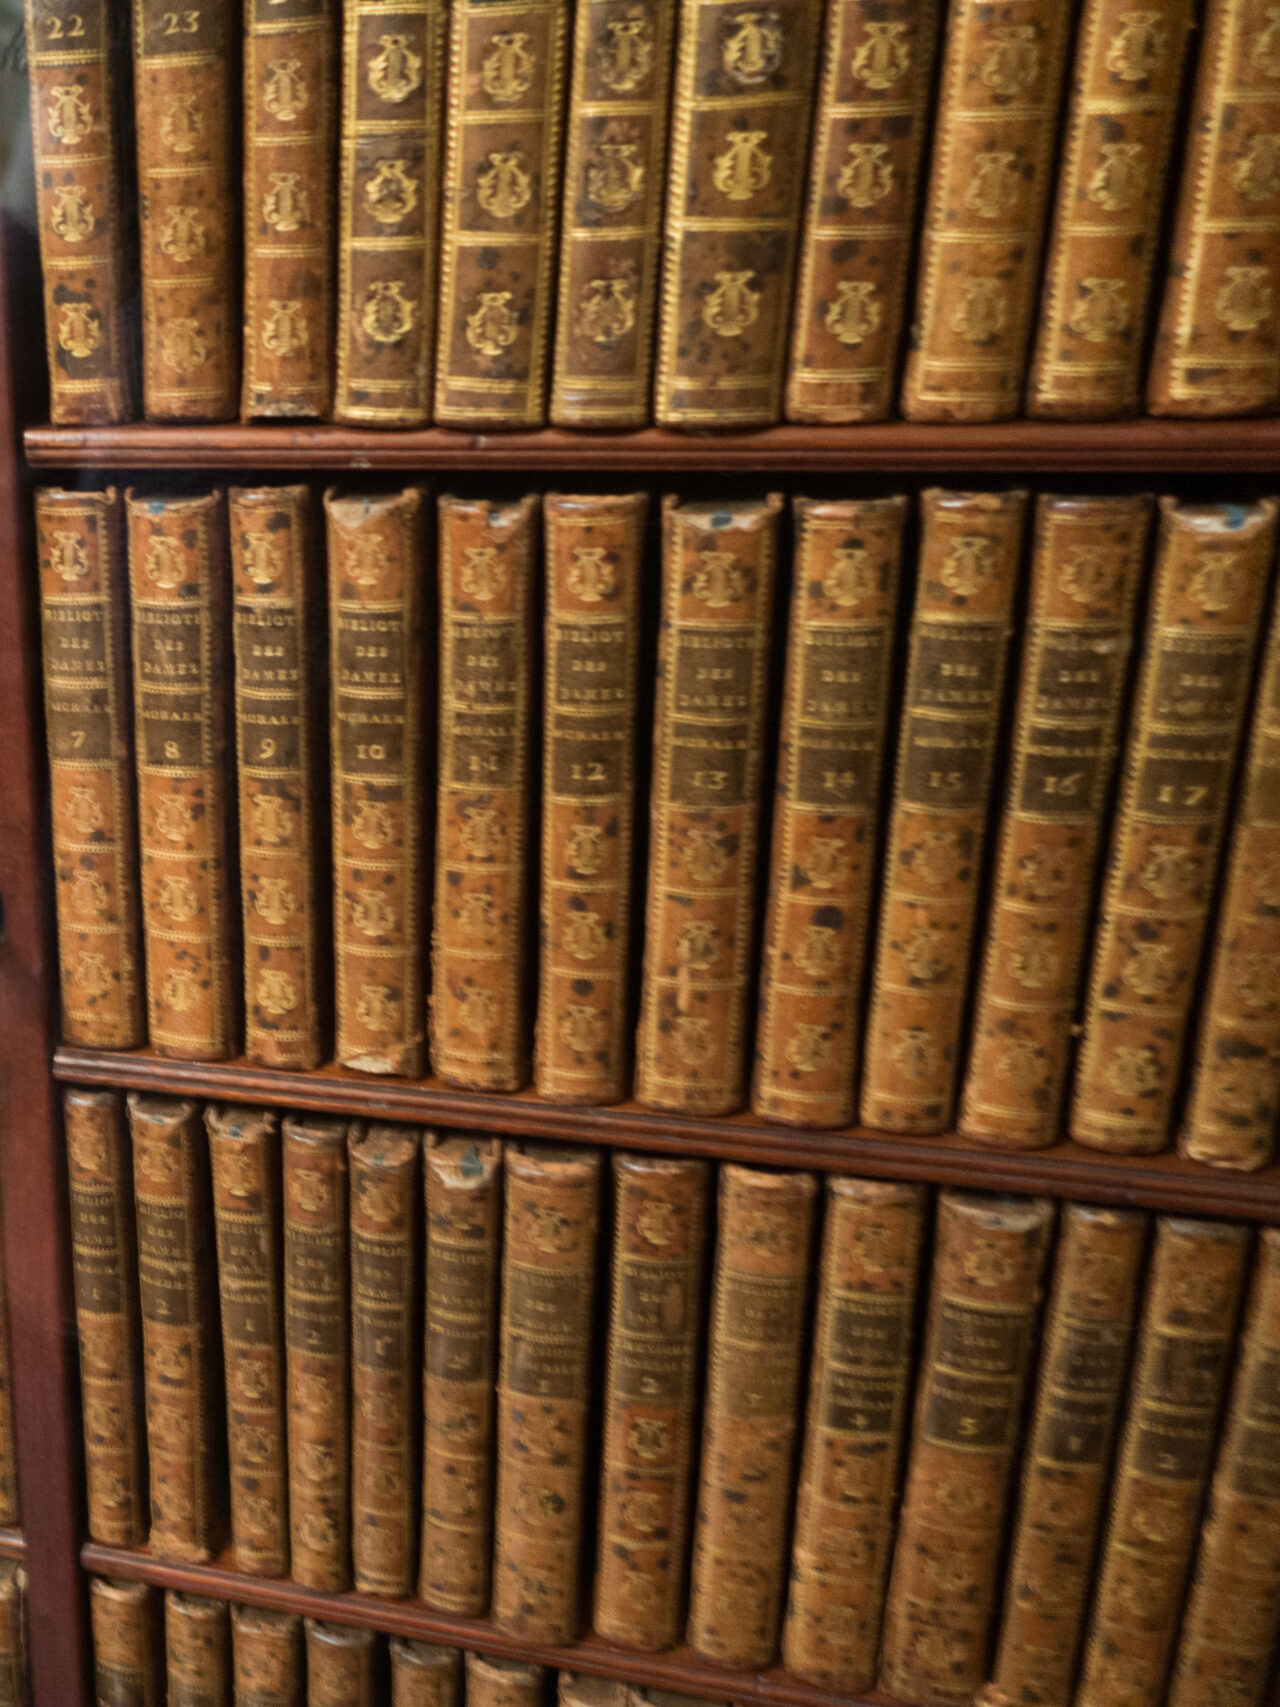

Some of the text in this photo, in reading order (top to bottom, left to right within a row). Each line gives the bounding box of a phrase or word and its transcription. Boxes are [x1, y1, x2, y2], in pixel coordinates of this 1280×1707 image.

[45, 14, 86, 40] 22
[163, 10, 201, 35] 23
[70, 729, 87, 749] 7
[163, 739, 181, 760] 8
[258, 737, 277, 760] 9
[355, 743, 387, 761] 10
[569, 761, 607, 782] 12
[692, 770, 729, 791] 13
[927, 770, 963, 790] 15
[1041, 773, 1083, 797] 16
[1157, 783, 1209, 807] 17
[154, 1297, 172, 1316] 2
[956, 1416, 979, 1436] 5
